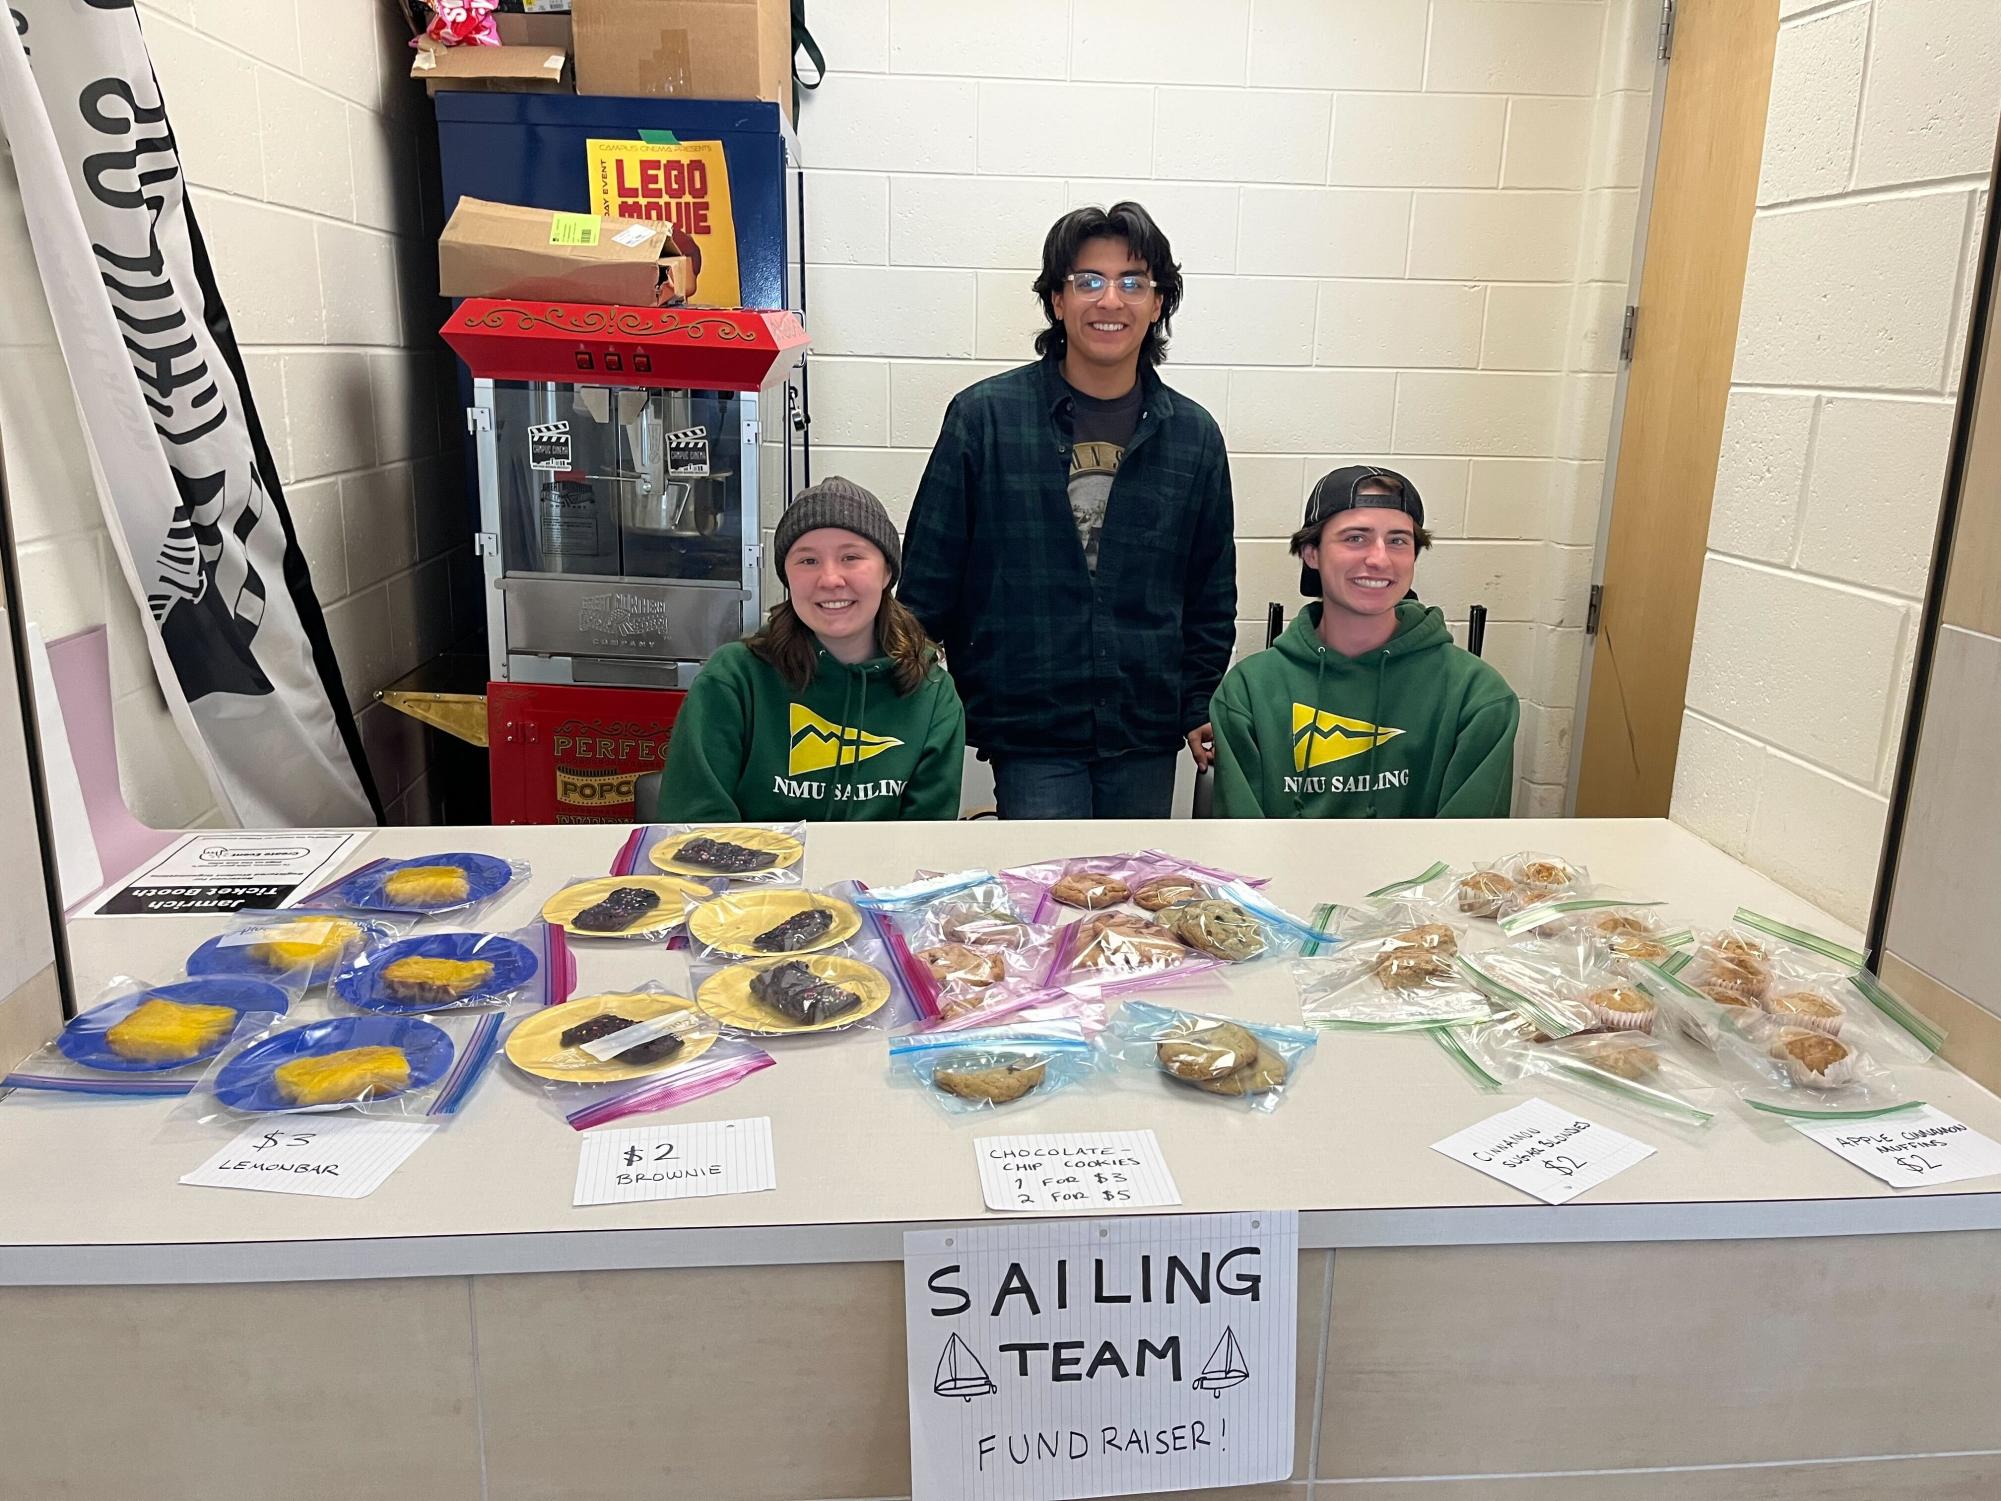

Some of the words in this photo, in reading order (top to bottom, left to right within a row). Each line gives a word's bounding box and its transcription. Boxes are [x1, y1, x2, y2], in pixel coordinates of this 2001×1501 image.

[599, 144, 638, 152] CAMPUS
[674, 145, 712, 153] PRESENTS
[600, 159, 608, 195] EVENT
[615, 159, 708, 199] LEGO
[619, 201, 711, 235] MOVIE
[773, 776, 826, 799] NMU
[832, 779, 907, 801] SAILIN
[1283, 776, 1326, 793] NMU
[1331, 769, 1409, 793] SAILING
[132, 888, 202, 897] Booth
[206, 887, 278, 896] Ticket
[148, 899, 245, 909] Jamrich
[1473, 1127, 1542, 1162] CINNAMON
[1836, 1132, 1894, 1149] APPLE
[1901, 1123, 1967, 1141] CINNAMON
[1876, 1139, 1948, 1154] MUFFINS
[218, 1159, 341, 1177] LEMONBAR
[1003, 1162, 1043, 1172] CHIP
[1064, 1157, 1141, 1168] COOKIES
[1502, 1147, 1545, 1168] SUGAR
[1542, 1155, 1588, 1177] $2
[1894, 1154, 1943, 1175] $2
[616, 1164, 723, 1186] BROWNIE
[1014, 1178, 1023, 1190] 1
[1042, 1175, 1080, 1187] FOR
[1093, 1172, 1128, 1184] $3
[1017, 1193, 1035, 1204] 2
[1051, 1191, 1089, 1203] FOR
[1102, 1190, 1131, 1202] $5
[927, 1246, 1262, 1317] SAILING
[998, 1335, 1182, 1382] TEAM
